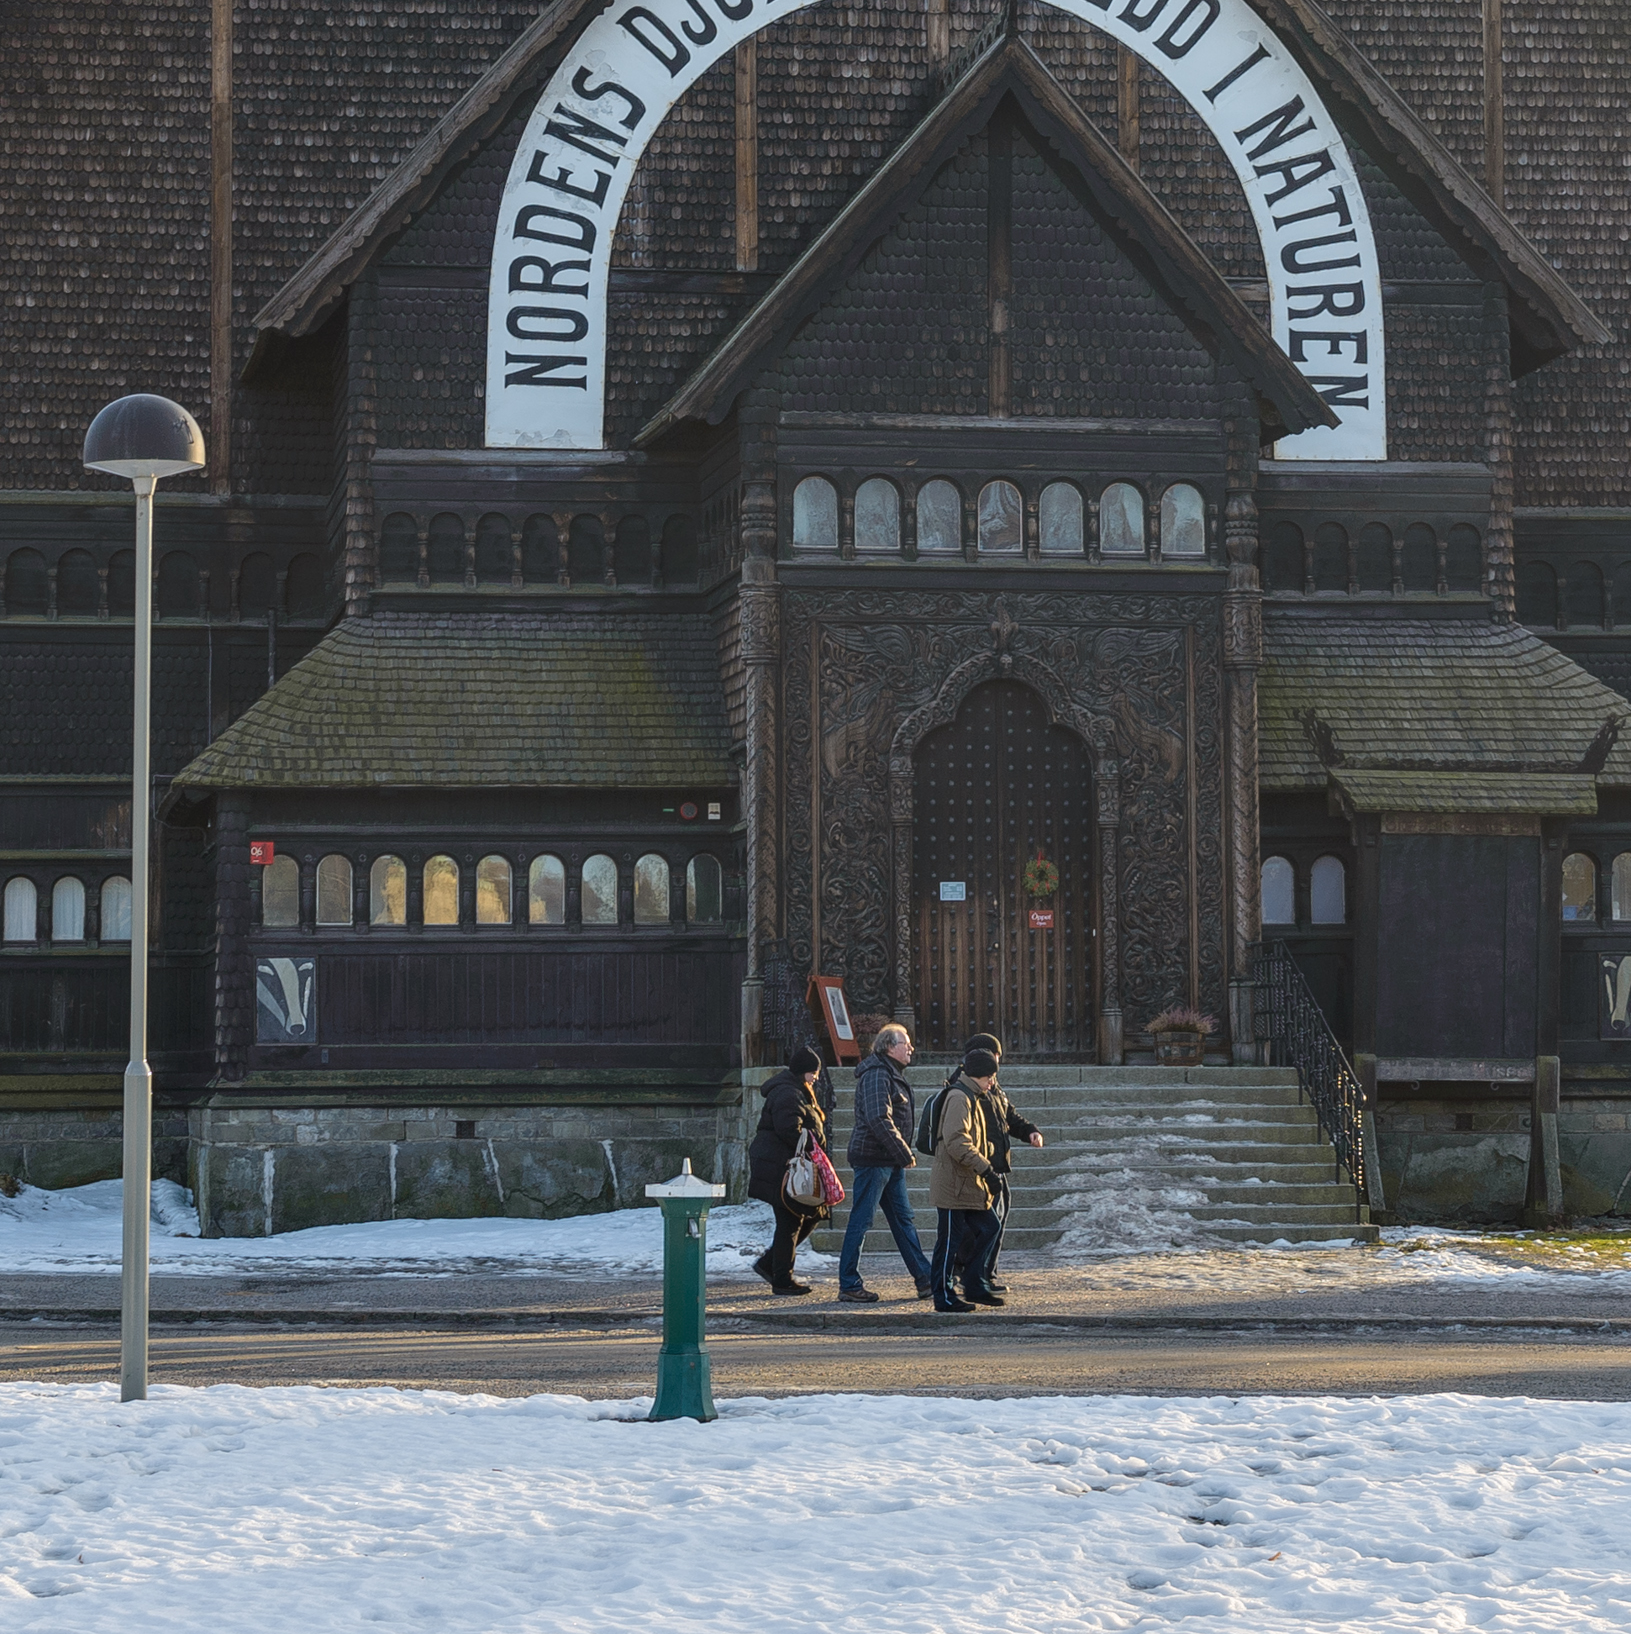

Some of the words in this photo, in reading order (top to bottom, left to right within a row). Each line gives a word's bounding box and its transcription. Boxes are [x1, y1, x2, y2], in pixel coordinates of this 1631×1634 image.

[503, 66, 647, 391] NORDENS
[1202, 42, 1274, 99] I
[1233, 93, 1370, 409] NATUREN
